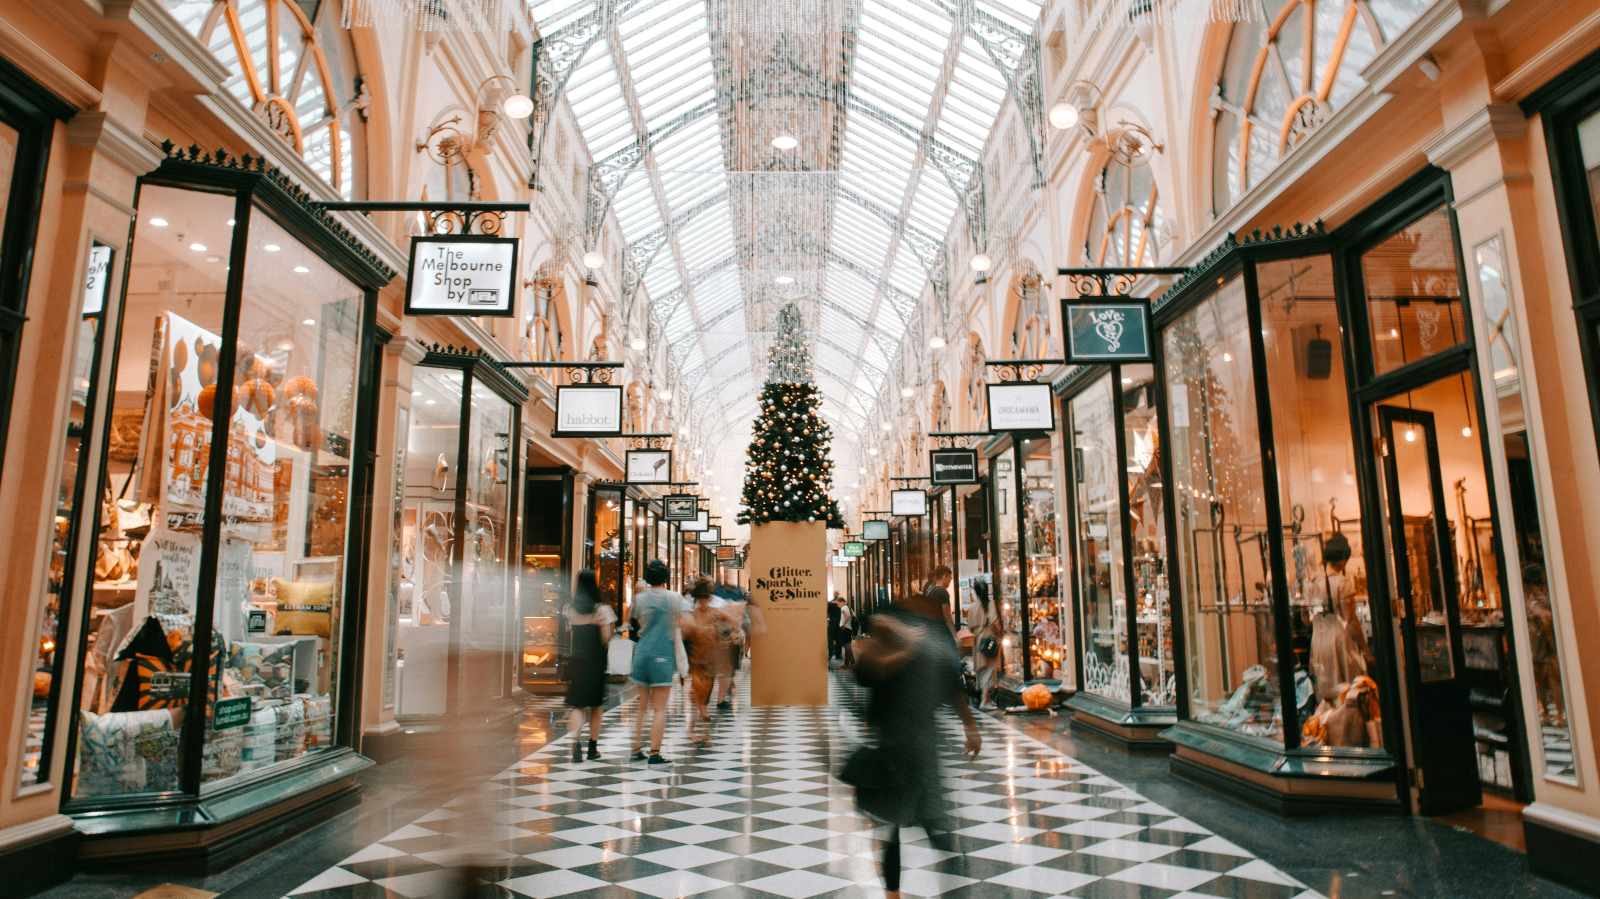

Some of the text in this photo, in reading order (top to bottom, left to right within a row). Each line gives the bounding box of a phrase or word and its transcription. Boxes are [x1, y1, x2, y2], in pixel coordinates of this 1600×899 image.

[438, 247, 463, 259] The
[422, 258, 503, 271] Melbourne
[434, 272, 472, 289] Shop
[448, 288, 465, 302] by
[769, 566, 812, 579] Glitter.
[756, 577, 803, 590] Sparkle
